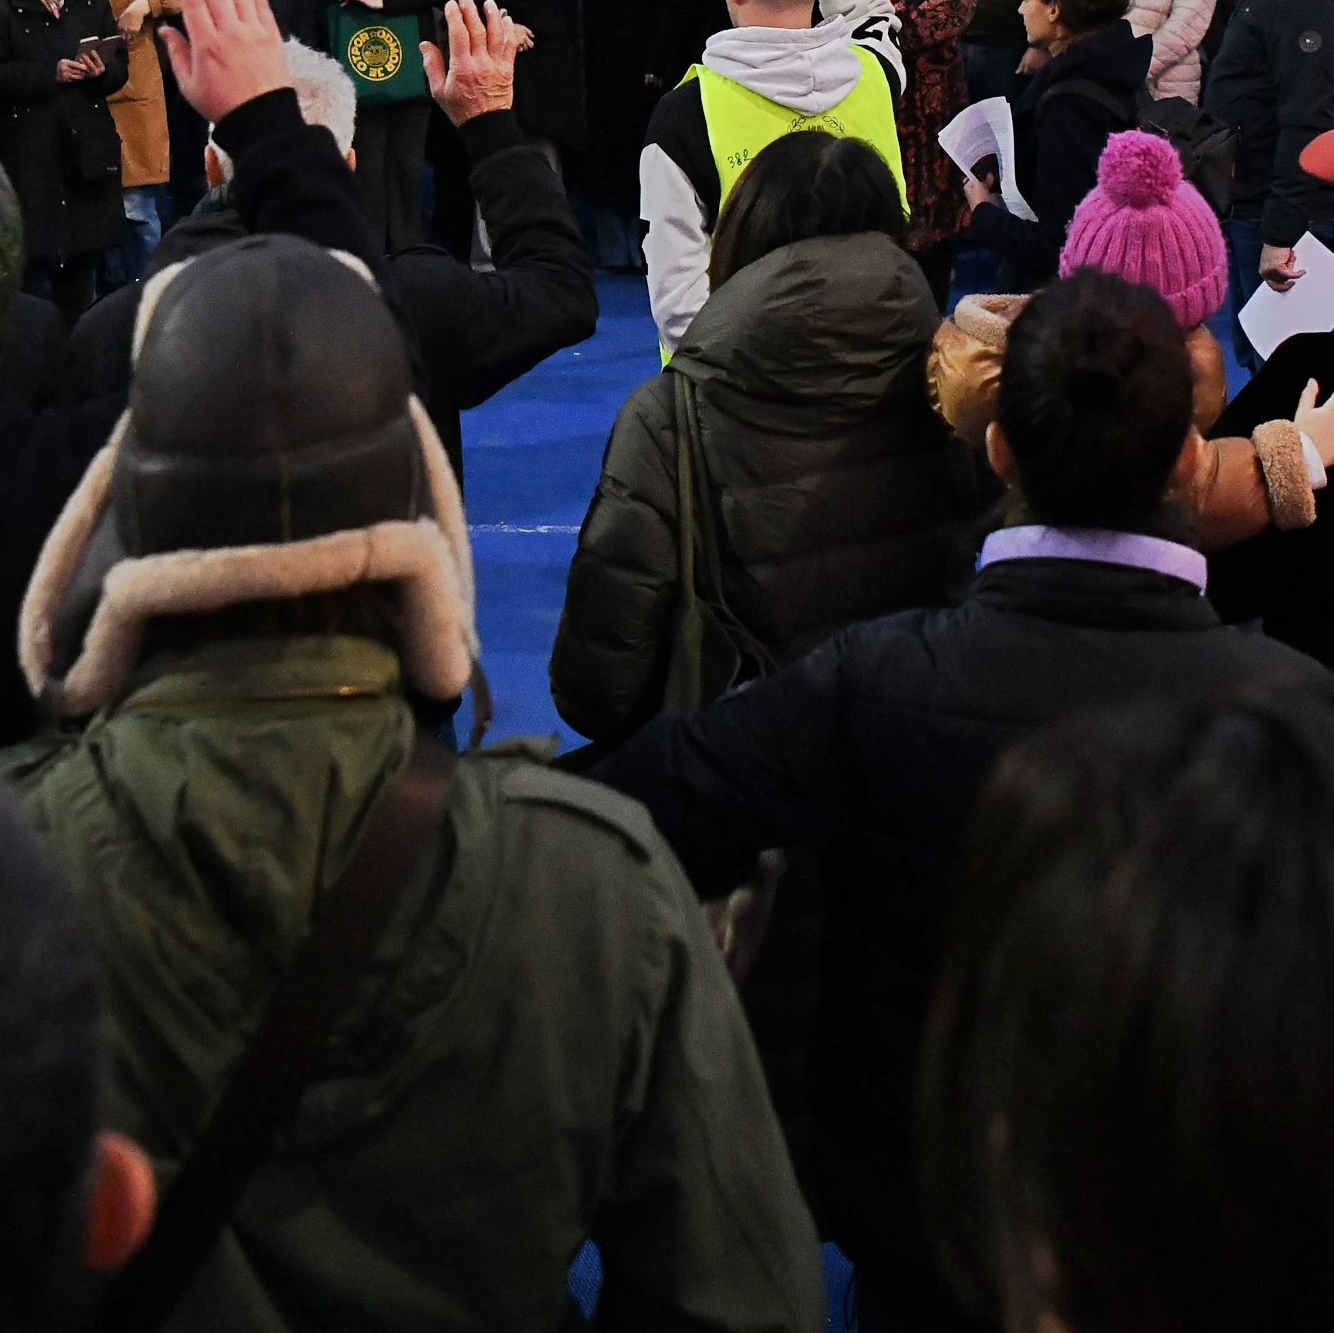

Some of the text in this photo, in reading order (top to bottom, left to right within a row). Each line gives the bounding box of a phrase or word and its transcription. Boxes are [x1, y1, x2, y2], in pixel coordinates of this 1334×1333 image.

[351, 29, 399, 77] ODMOR JE OTPOR
